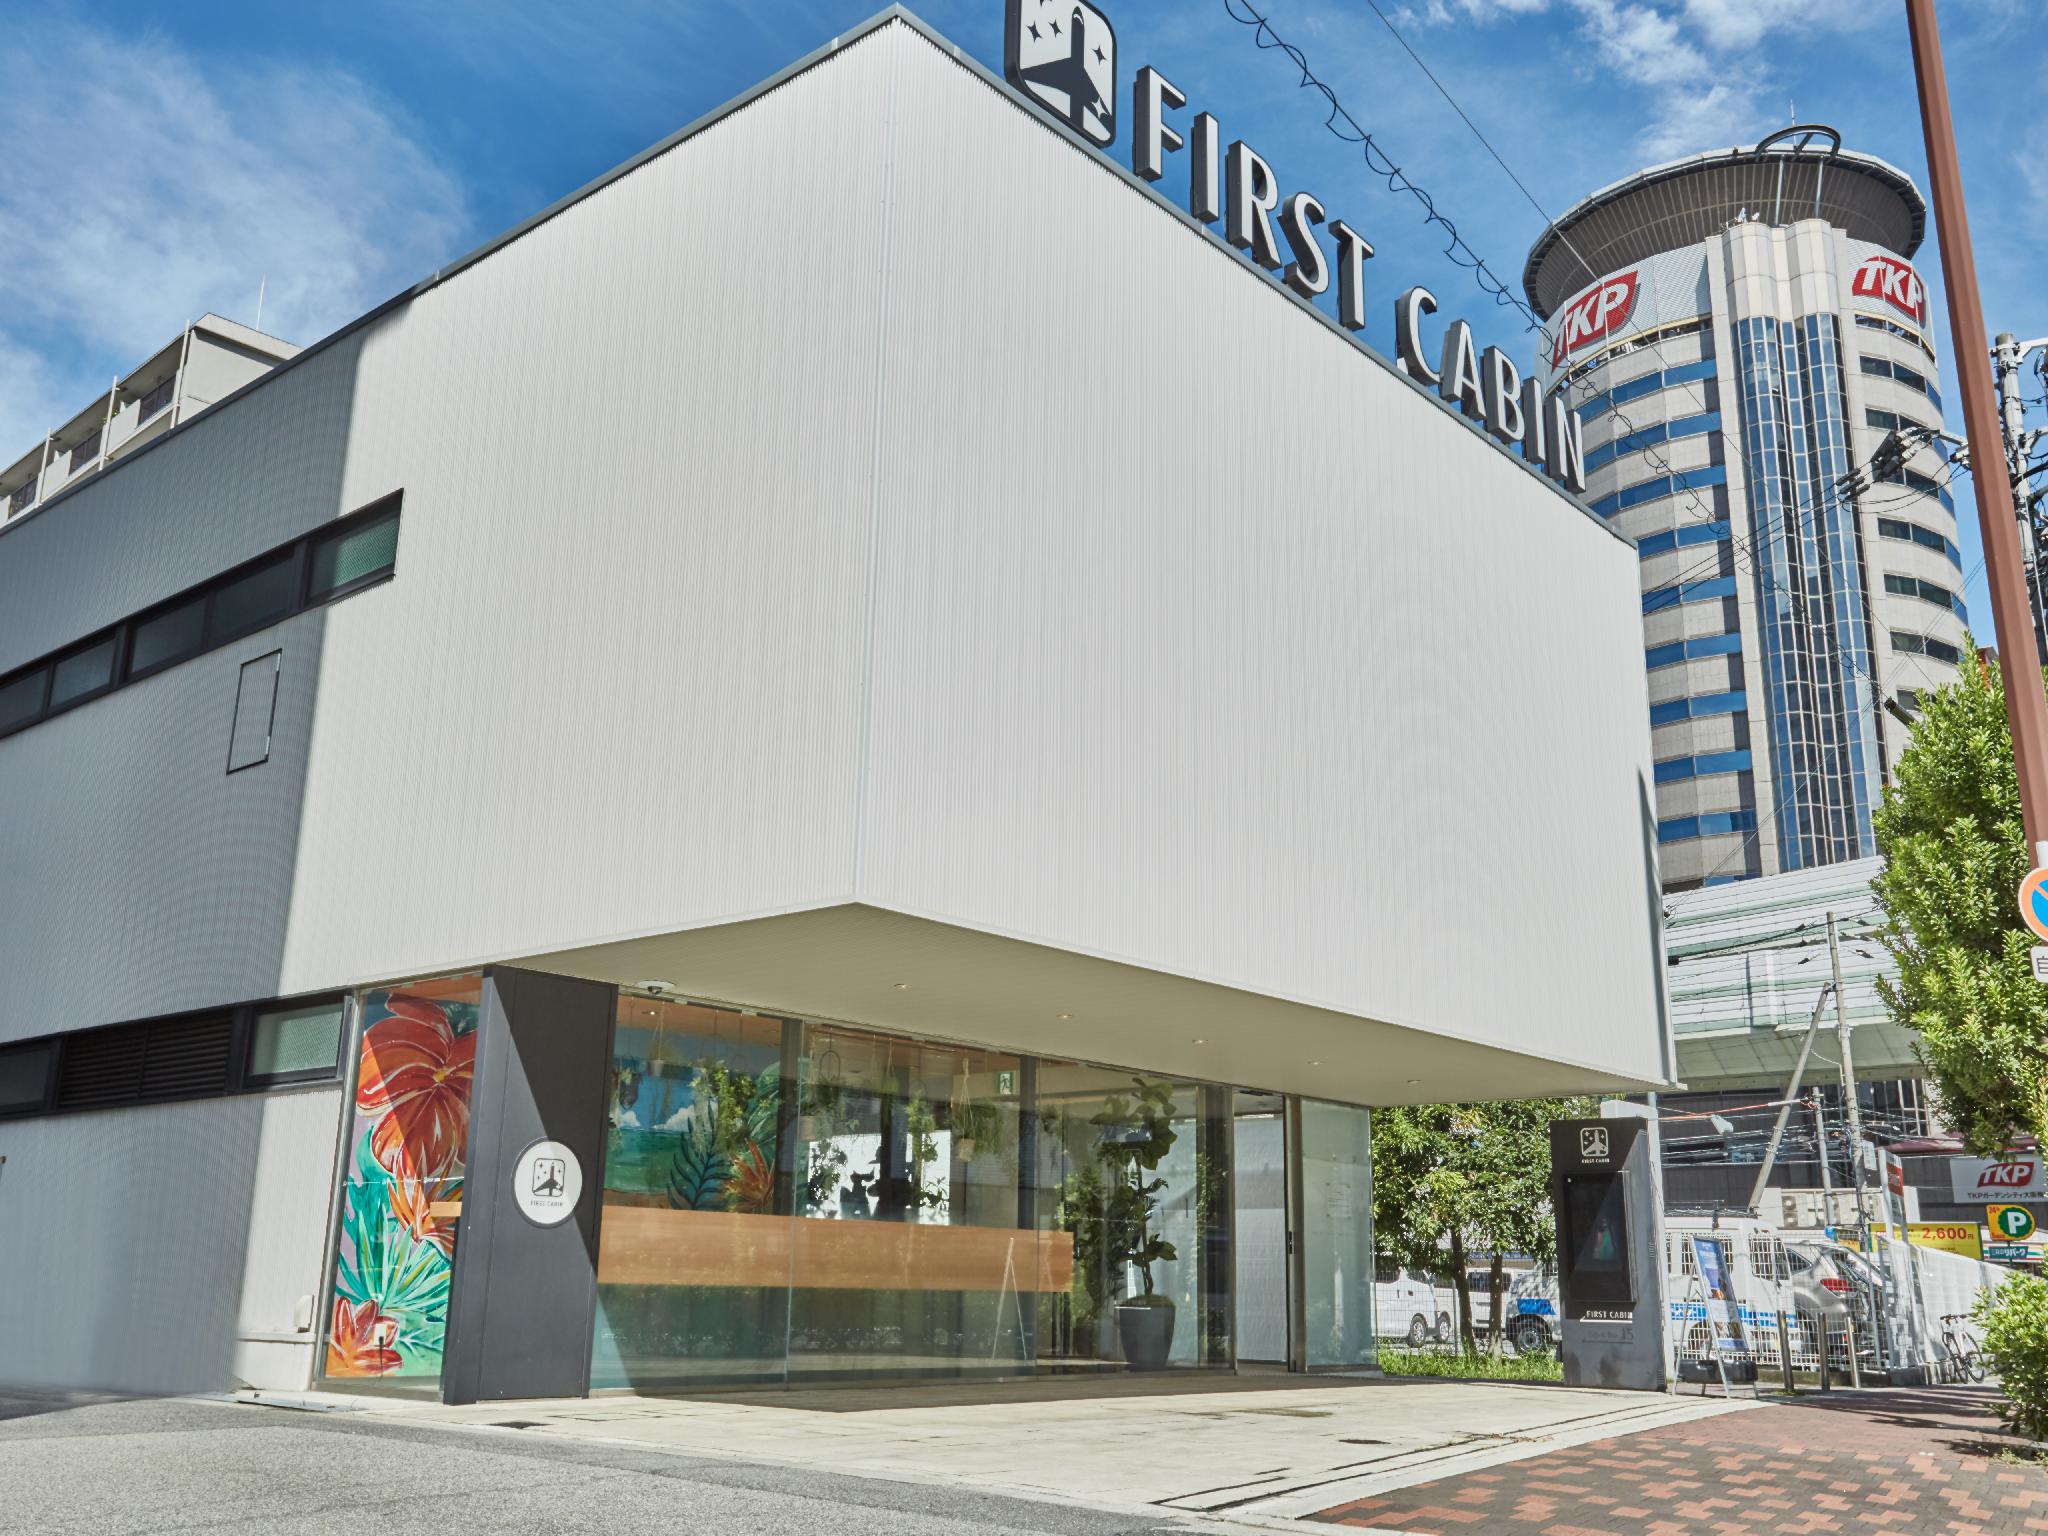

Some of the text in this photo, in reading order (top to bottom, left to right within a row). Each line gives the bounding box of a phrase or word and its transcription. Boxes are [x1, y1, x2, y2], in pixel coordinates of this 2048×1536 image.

[1132, 65, 1586, 493] FIRST CABIN
[1857, 260, 1923, 309] TKP
[1556, 282, 1629, 358] TKP
[1983, 1165, 2031, 1184] TKP
[2007, 1211, 2027, 1234] P
[1586, 1310, 1633, 1319] FIRST CABIN
